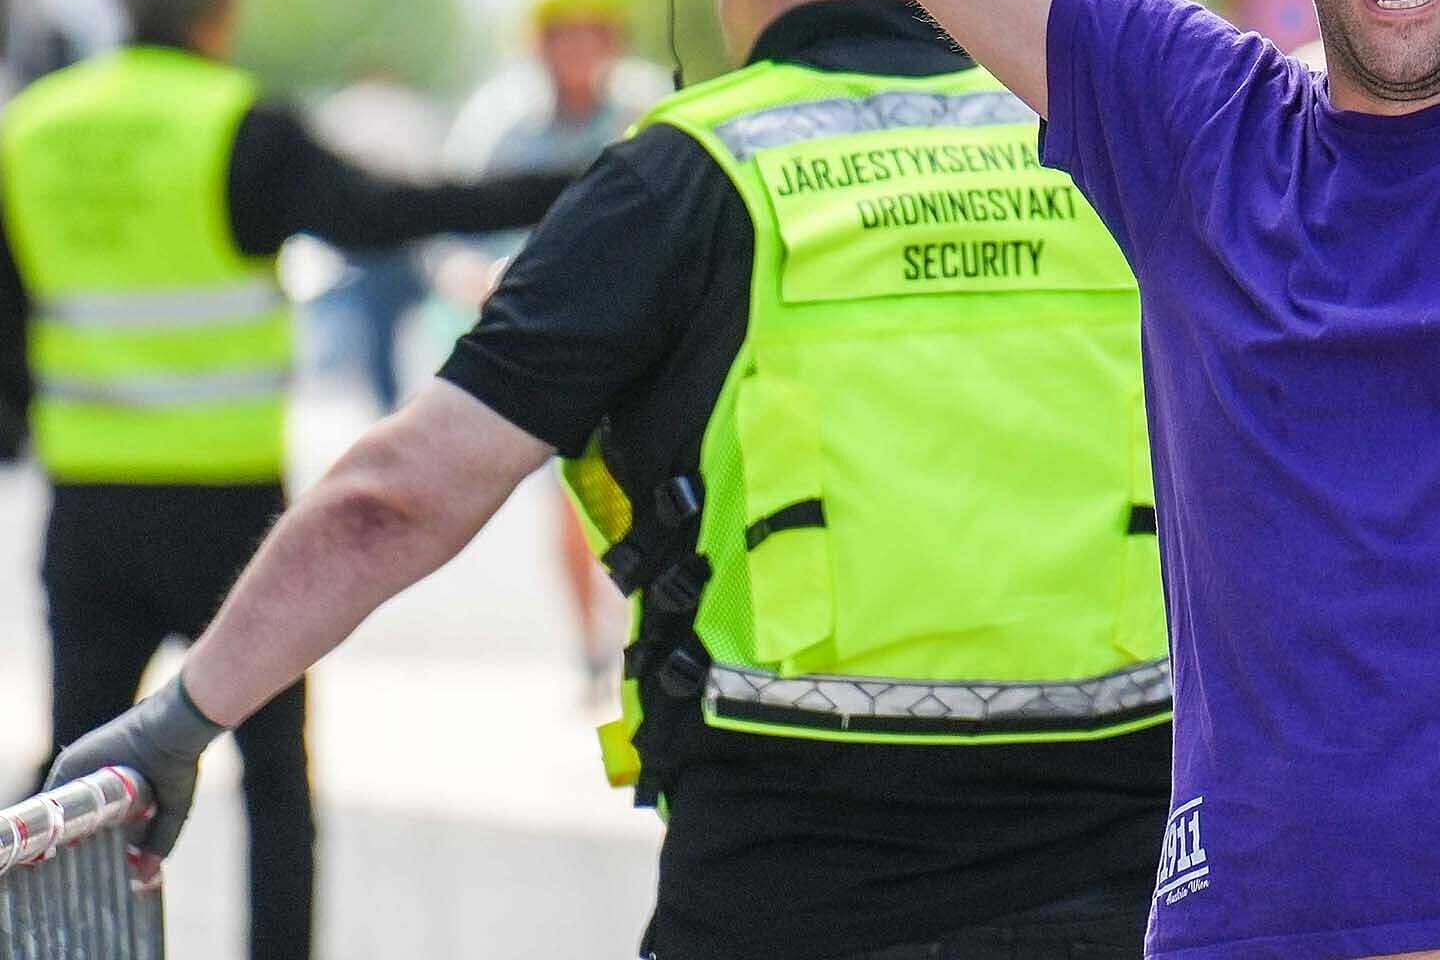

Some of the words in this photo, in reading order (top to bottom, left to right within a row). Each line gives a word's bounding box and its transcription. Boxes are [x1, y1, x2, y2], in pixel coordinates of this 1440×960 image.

[777, 143, 1039, 196] JÄRJESTYKSENVA
[857, 186, 1076, 228] ORDNINGSVAKT
[903, 240, 1046, 280] SECURITY
